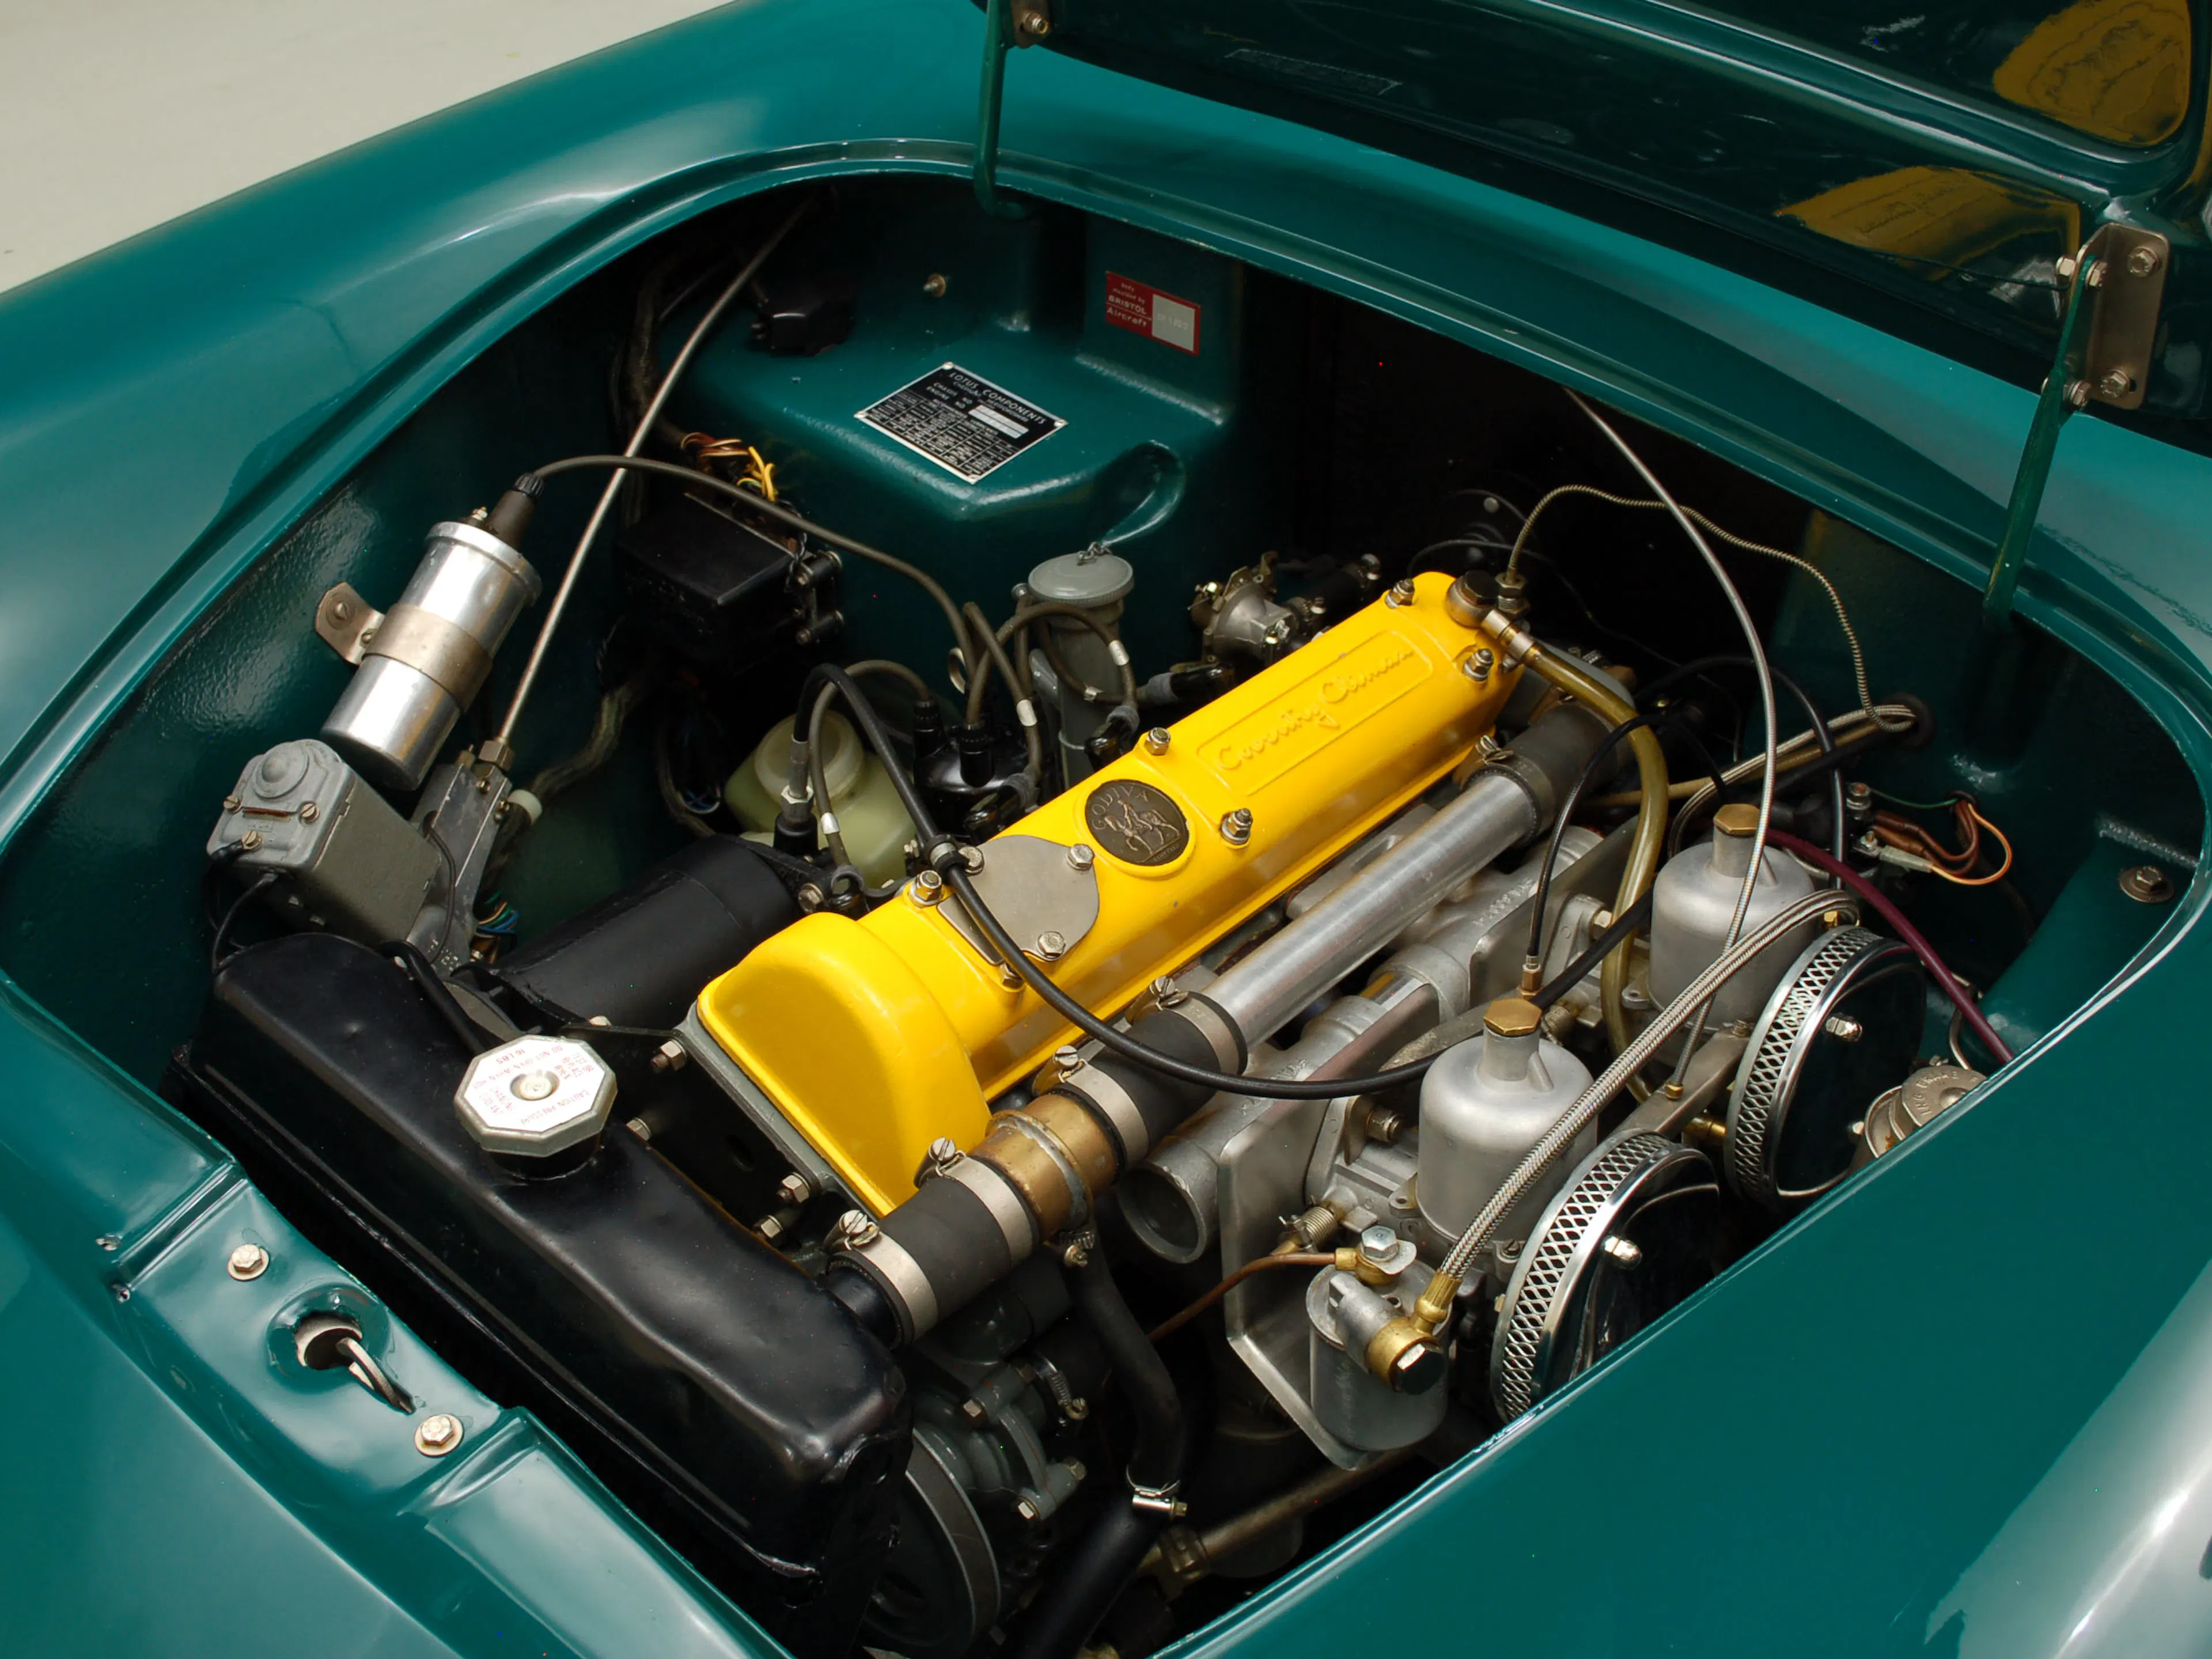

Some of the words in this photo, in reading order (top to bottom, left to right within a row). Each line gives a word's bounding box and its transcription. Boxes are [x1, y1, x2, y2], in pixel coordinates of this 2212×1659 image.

[1107, 306, 1147, 328] Aircraft
[1108, 294, 1147, 315] BRISTOL
[948, 372, 980, 389] LOTUS
[980, 388, 1048, 425] COMPONENTS
[1215, 707, 1341, 771] Coventry
[1091, 785, 1149, 831] GODIVA
